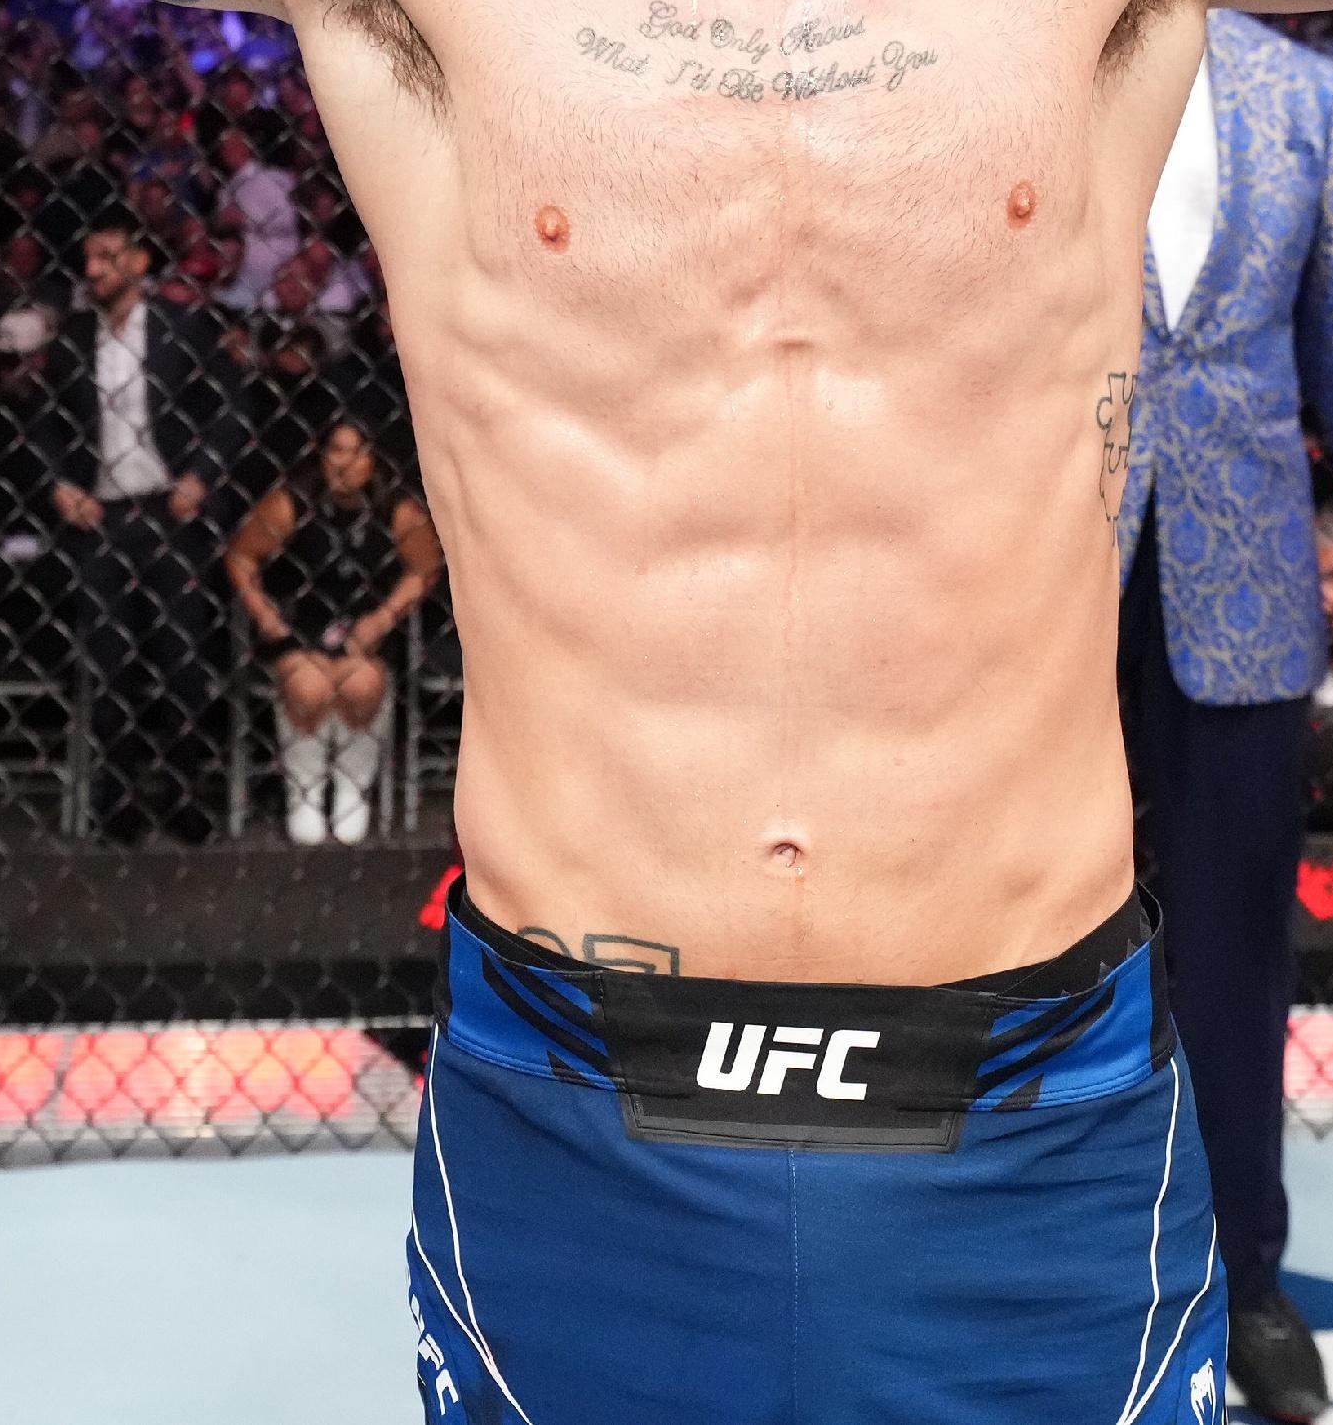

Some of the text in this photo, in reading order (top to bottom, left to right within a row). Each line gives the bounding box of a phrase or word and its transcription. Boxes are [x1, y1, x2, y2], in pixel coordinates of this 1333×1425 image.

[576, 27, 938, 103] What I'd Be Without You
[637, 0, 705, 40] God
[710, 18, 770, 64] Only
[697, 1022, 880, 1100] UFC
